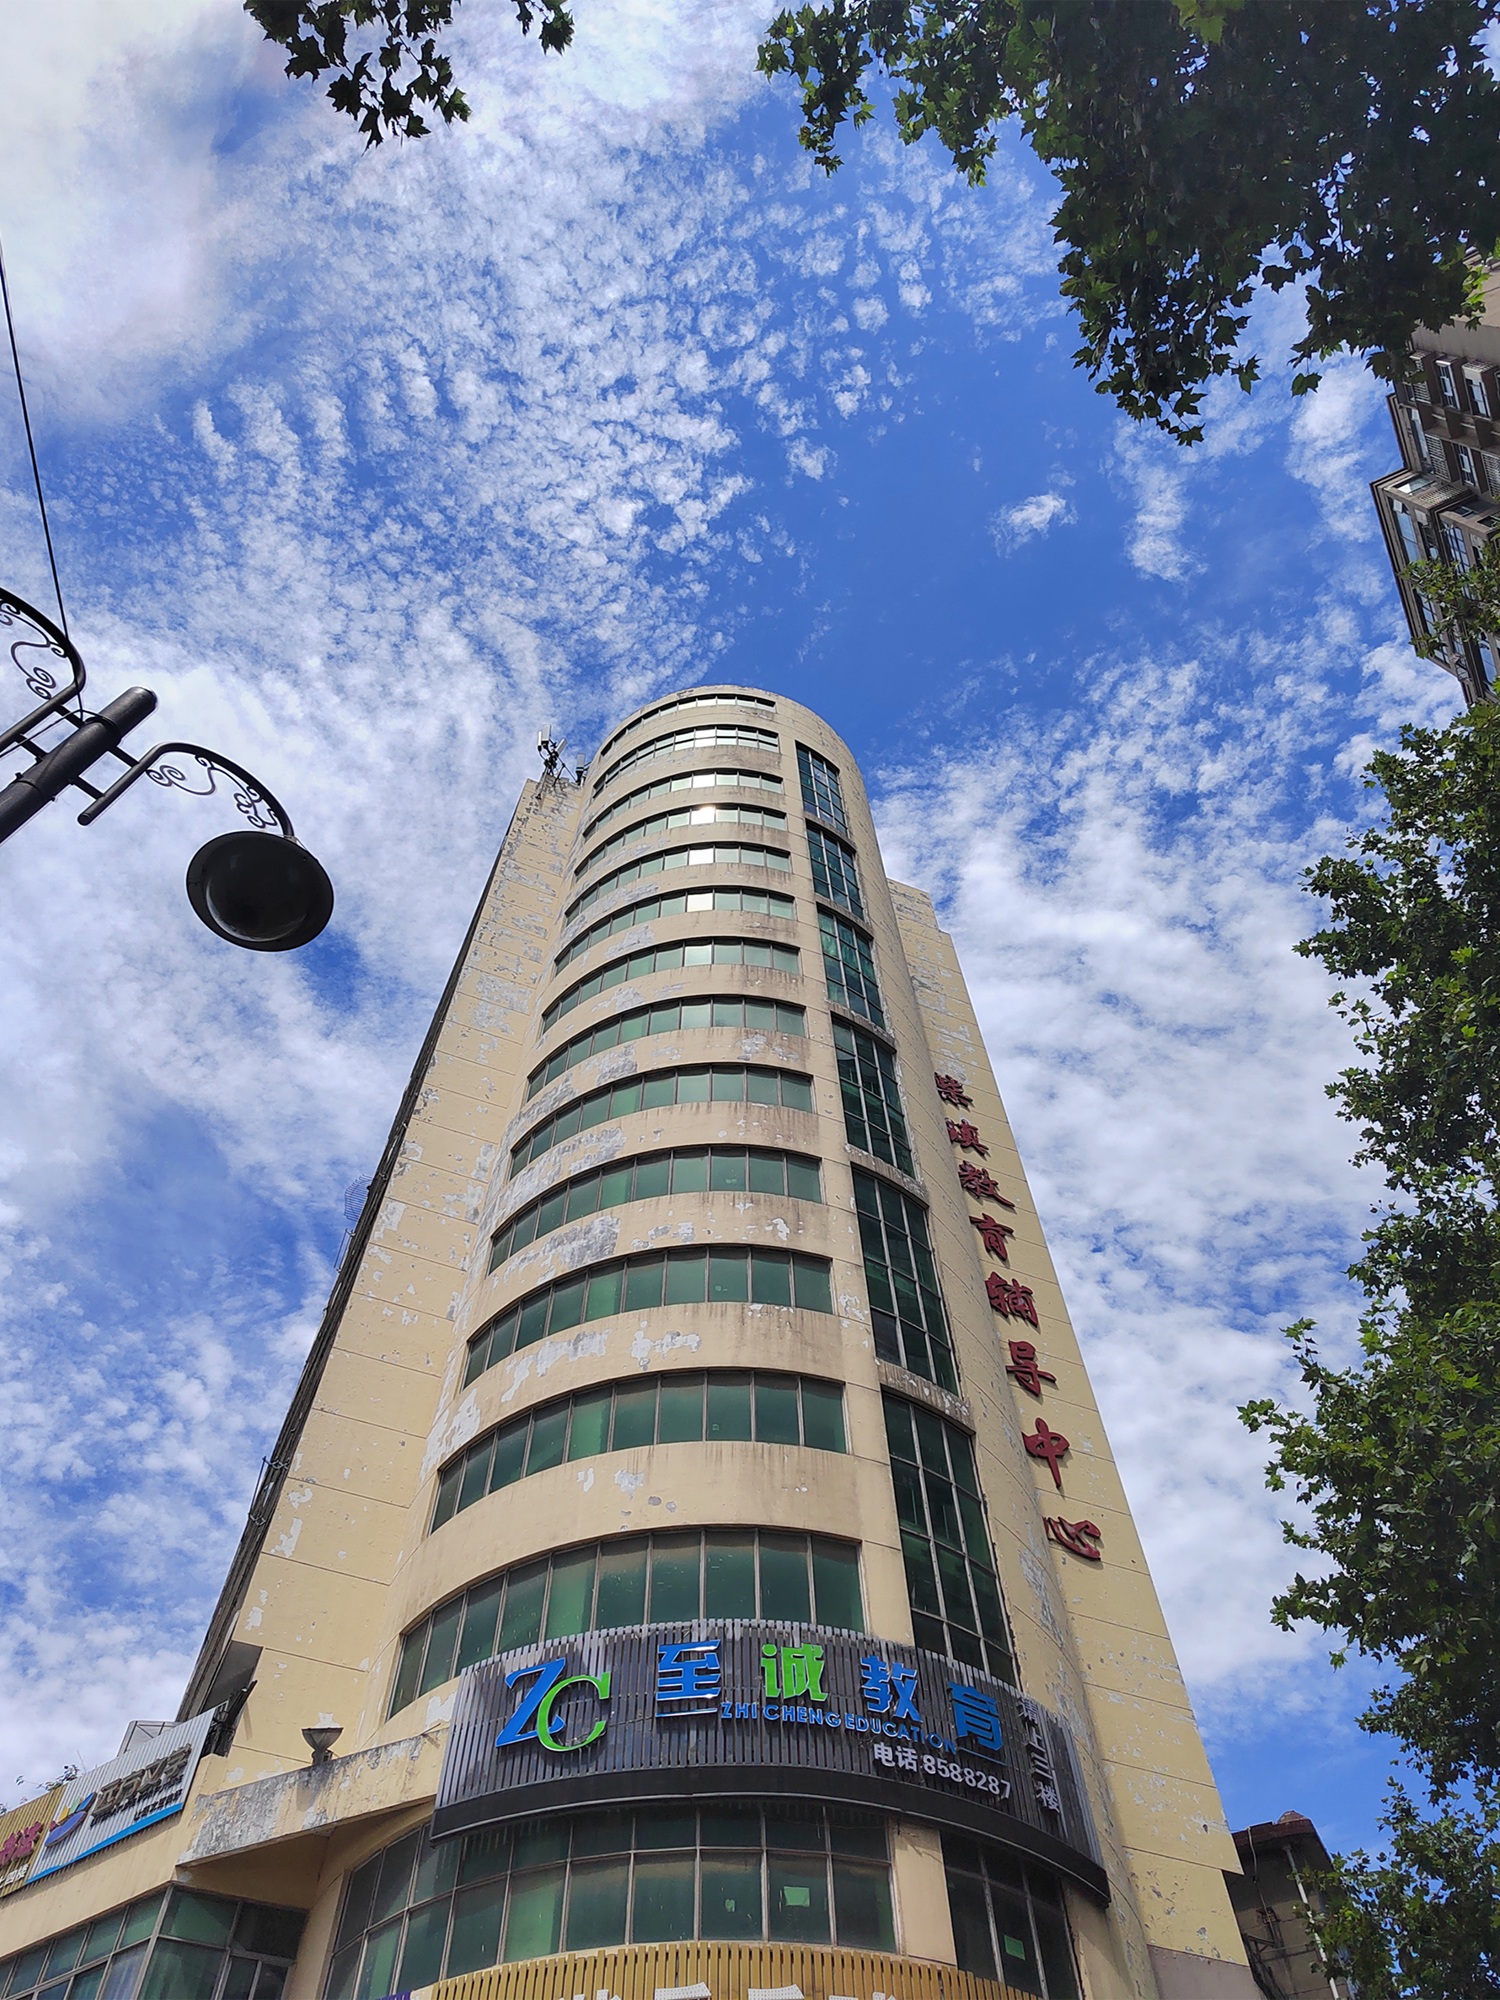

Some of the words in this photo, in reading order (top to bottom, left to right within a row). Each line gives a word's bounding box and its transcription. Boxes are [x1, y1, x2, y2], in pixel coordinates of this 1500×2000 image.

[496, 1657, 611, 1753] ZC
[656, 1640, 1003, 1752] 至诚教育
[720, 1702, 758, 1720] ZHI
[763, 1703, 843, 1729] CHENG
[844, 1712, 958, 1755] EDUCATION
